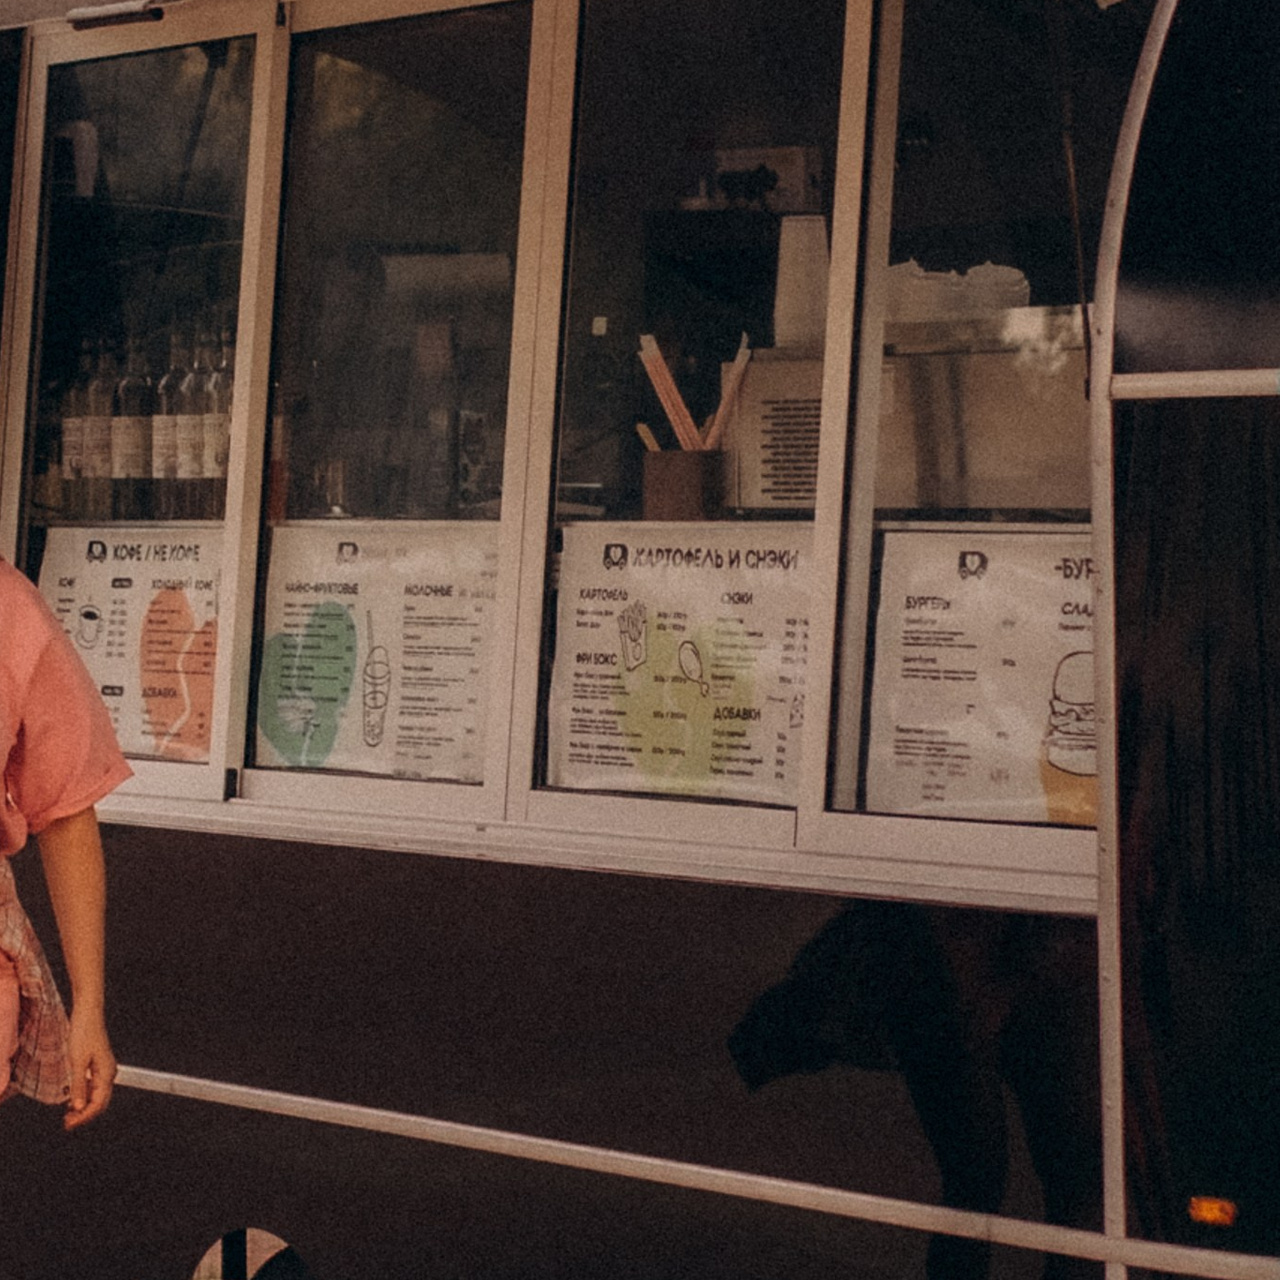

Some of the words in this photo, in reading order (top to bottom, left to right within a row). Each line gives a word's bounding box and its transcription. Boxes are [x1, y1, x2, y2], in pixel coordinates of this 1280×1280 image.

[112, 543, 143, 562] КОФЕ
[153, 544, 168, 562] НЕ
[632, 546, 723, 569] КАРТОФЕЛЬ
[728, 549, 741, 569] И
[744, 549, 799, 570] СНЭКИ
[404, 584, 454, 597] МОЛОЧНЫЕ
[578, 588, 629, 601] КАРТОФЕЛЬ
[720, 591, 754, 605] СНЭКИ
[594, 652, 618, 666] БОКС
[713, 706, 762, 721] ДОБАВКИ
